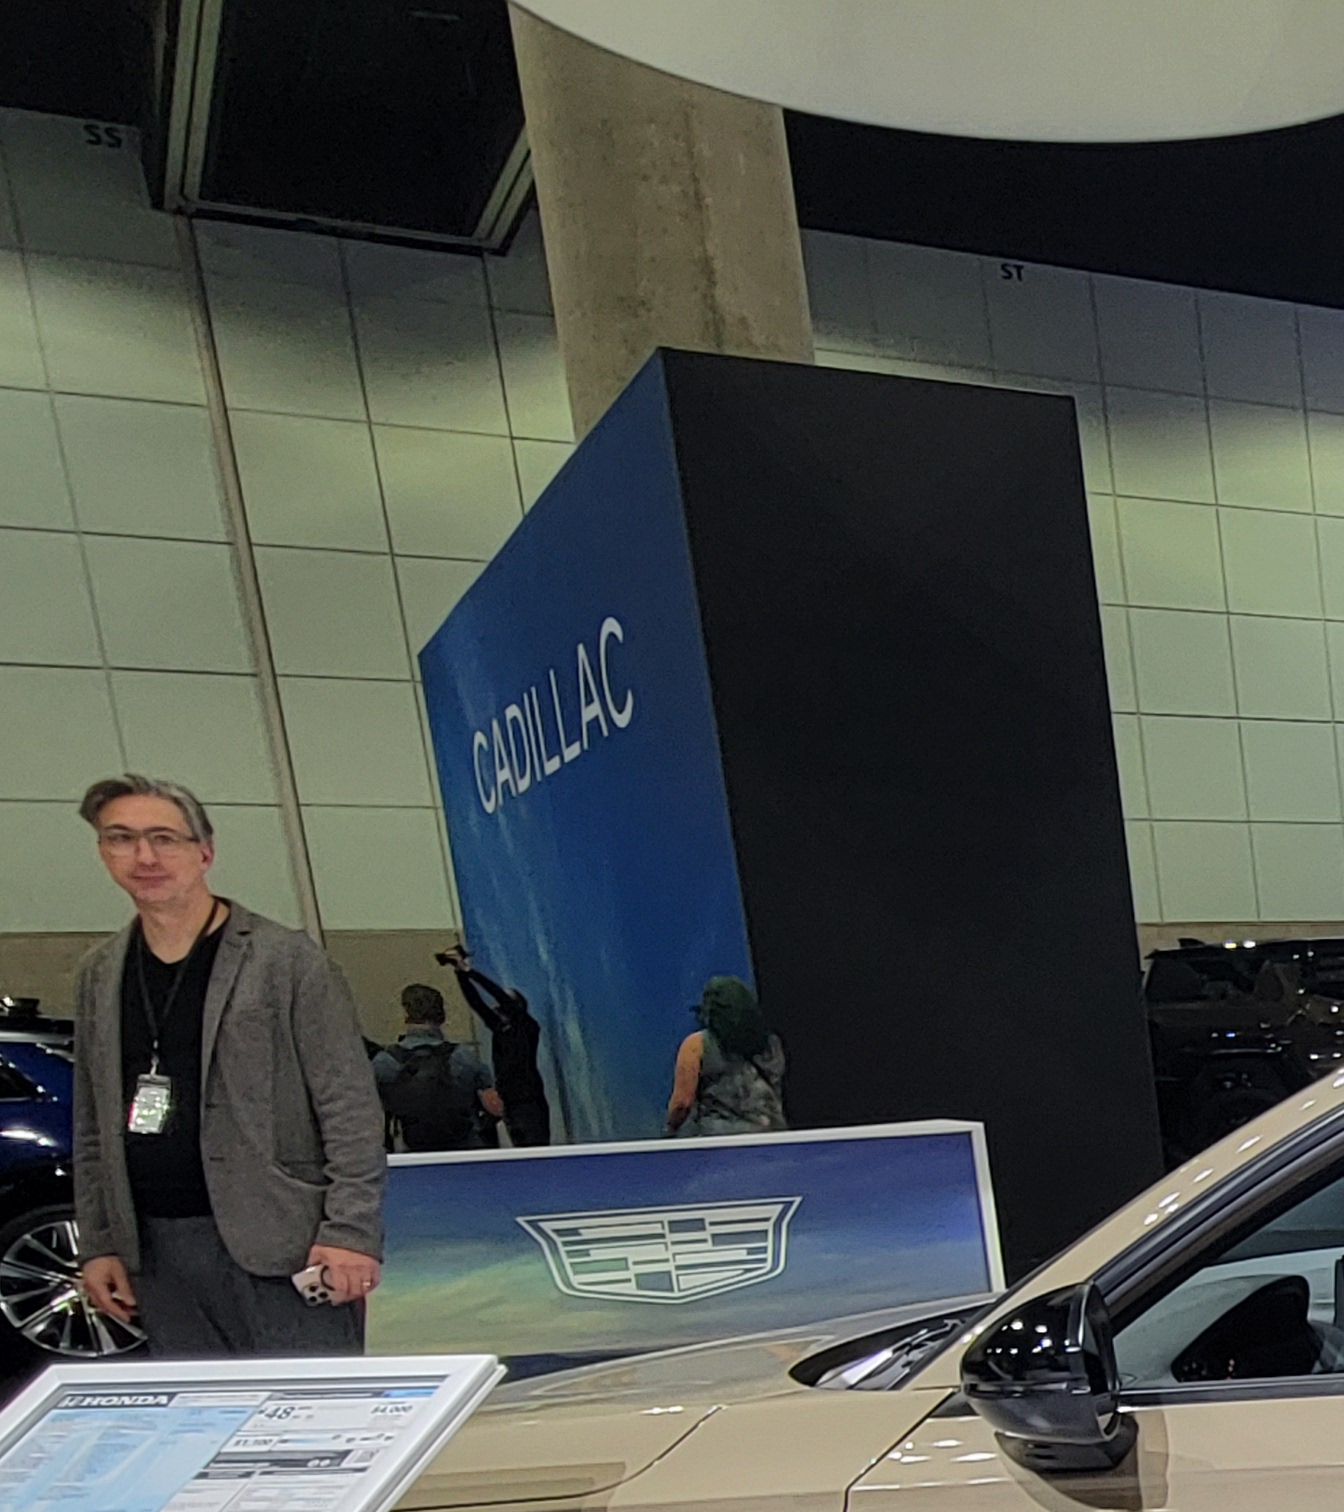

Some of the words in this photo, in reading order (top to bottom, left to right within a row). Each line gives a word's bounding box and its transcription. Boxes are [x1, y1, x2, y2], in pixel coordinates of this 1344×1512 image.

[82, 124, 123, 148] SS
[1000, 263, 1024, 282] ST
[473, 616, 634, 815] CADILLAC
[79, 1395, 168, 1406] HONDA
[264, 1405, 296, 1420] 48
